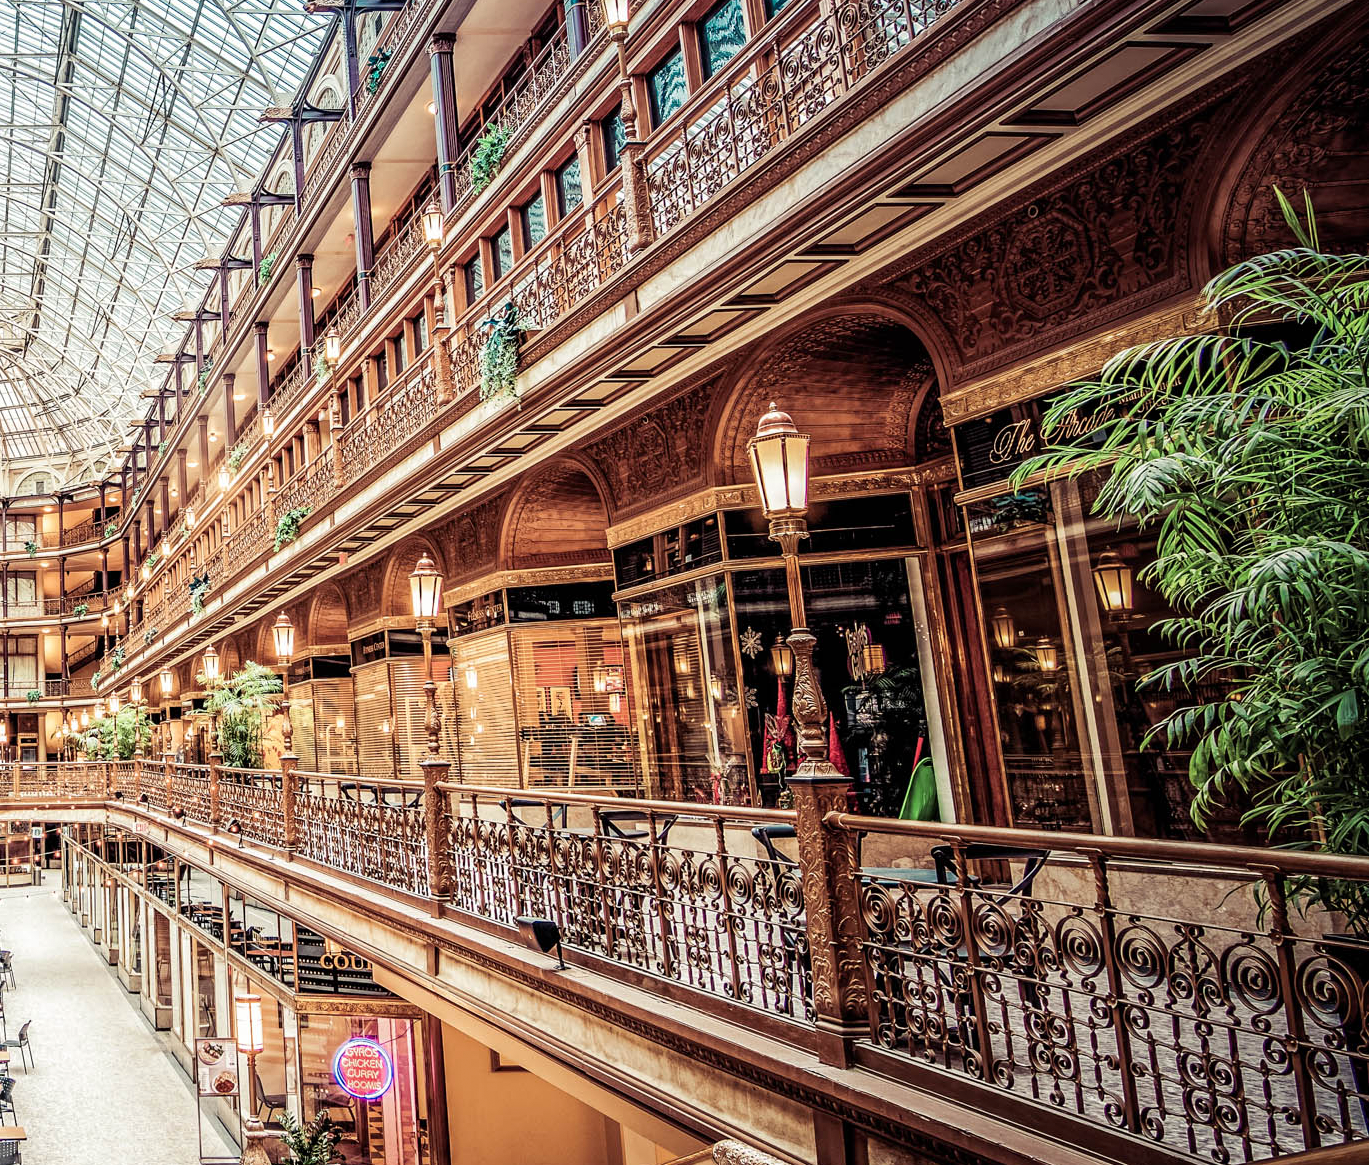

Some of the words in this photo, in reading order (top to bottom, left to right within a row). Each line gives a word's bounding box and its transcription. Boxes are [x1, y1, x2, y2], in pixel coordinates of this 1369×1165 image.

[989, 418, 1036, 463] The
[345, 1047, 379, 1058] GYROS
[341, 1057, 383, 1069] CHICKEN
[347, 1068, 379, 1079] CURRY
